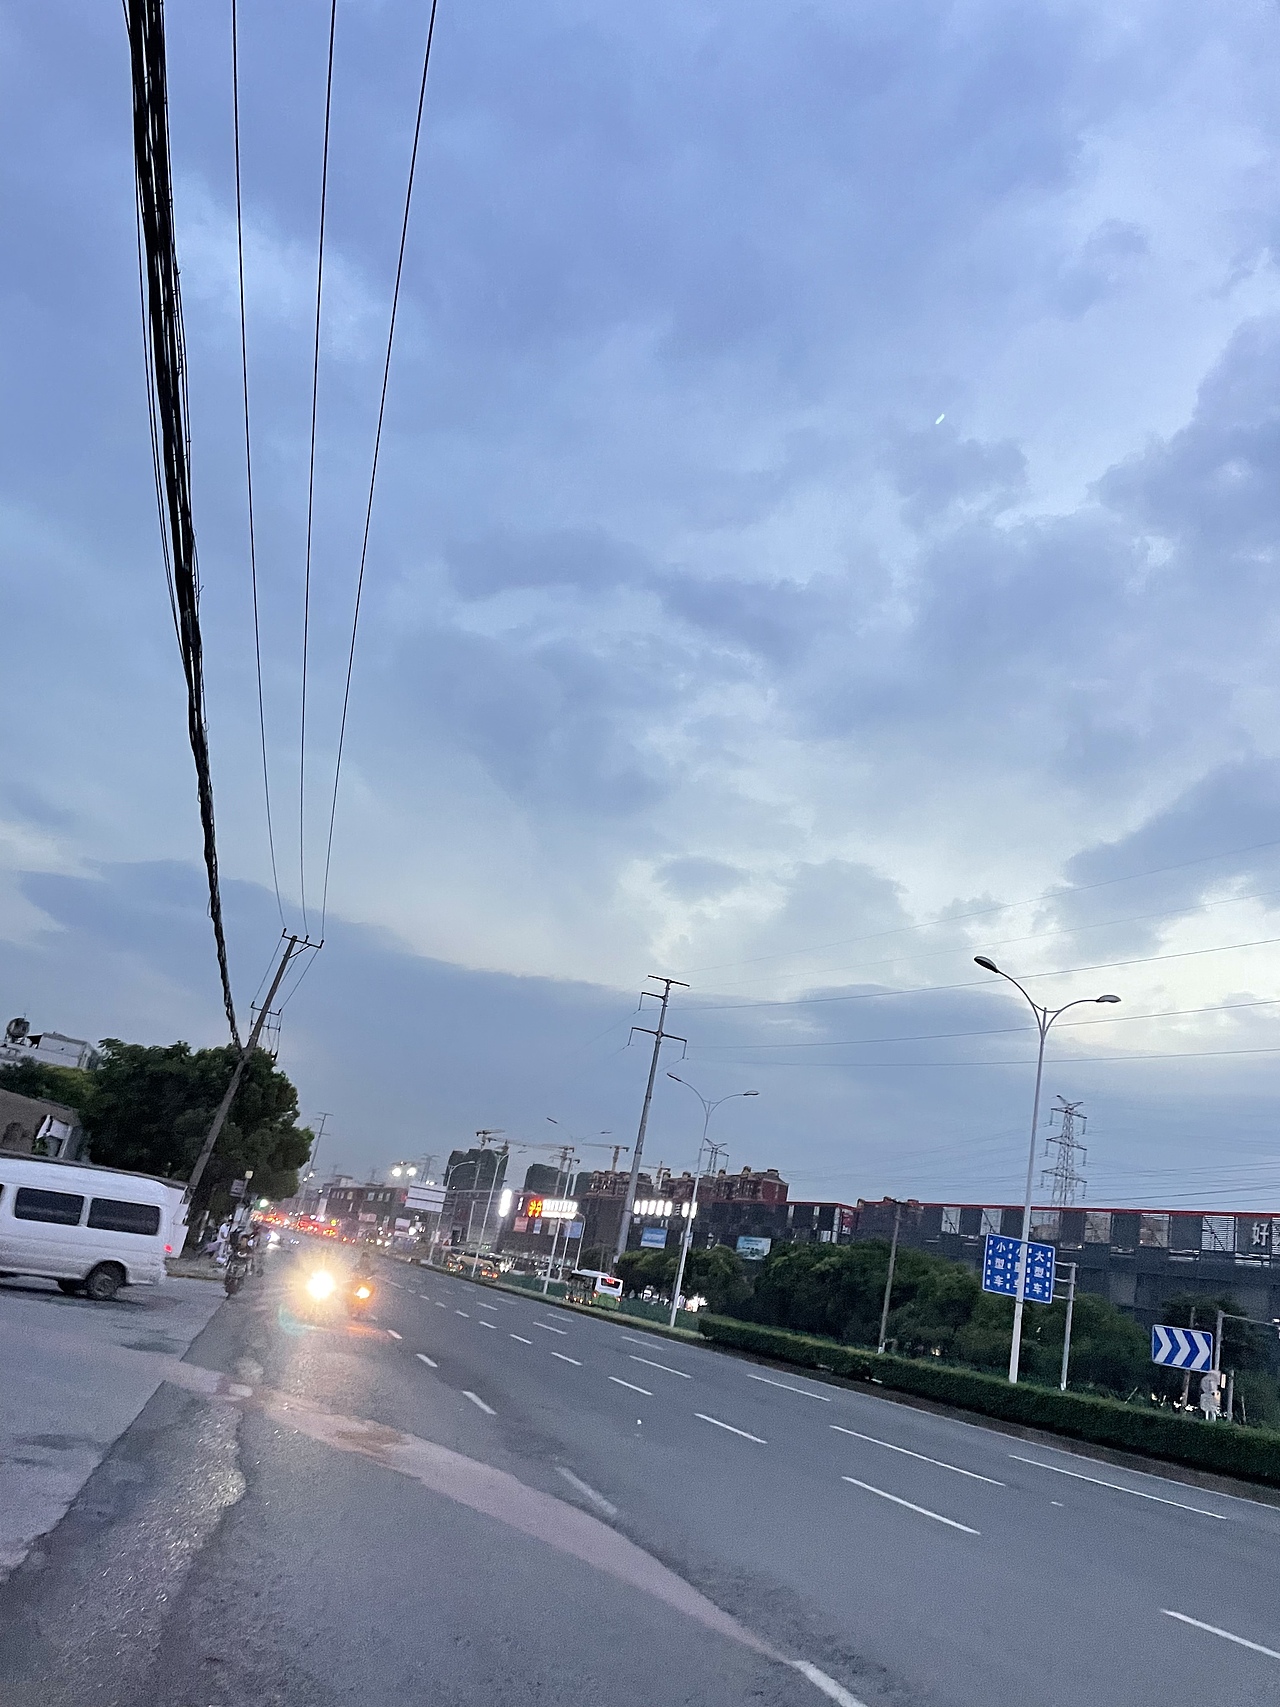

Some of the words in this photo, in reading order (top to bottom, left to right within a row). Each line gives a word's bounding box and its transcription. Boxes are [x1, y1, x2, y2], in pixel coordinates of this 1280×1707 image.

[994, 1242, 1006, 1287] 小型车
[1032, 1250, 1045, 1295] 大型车
